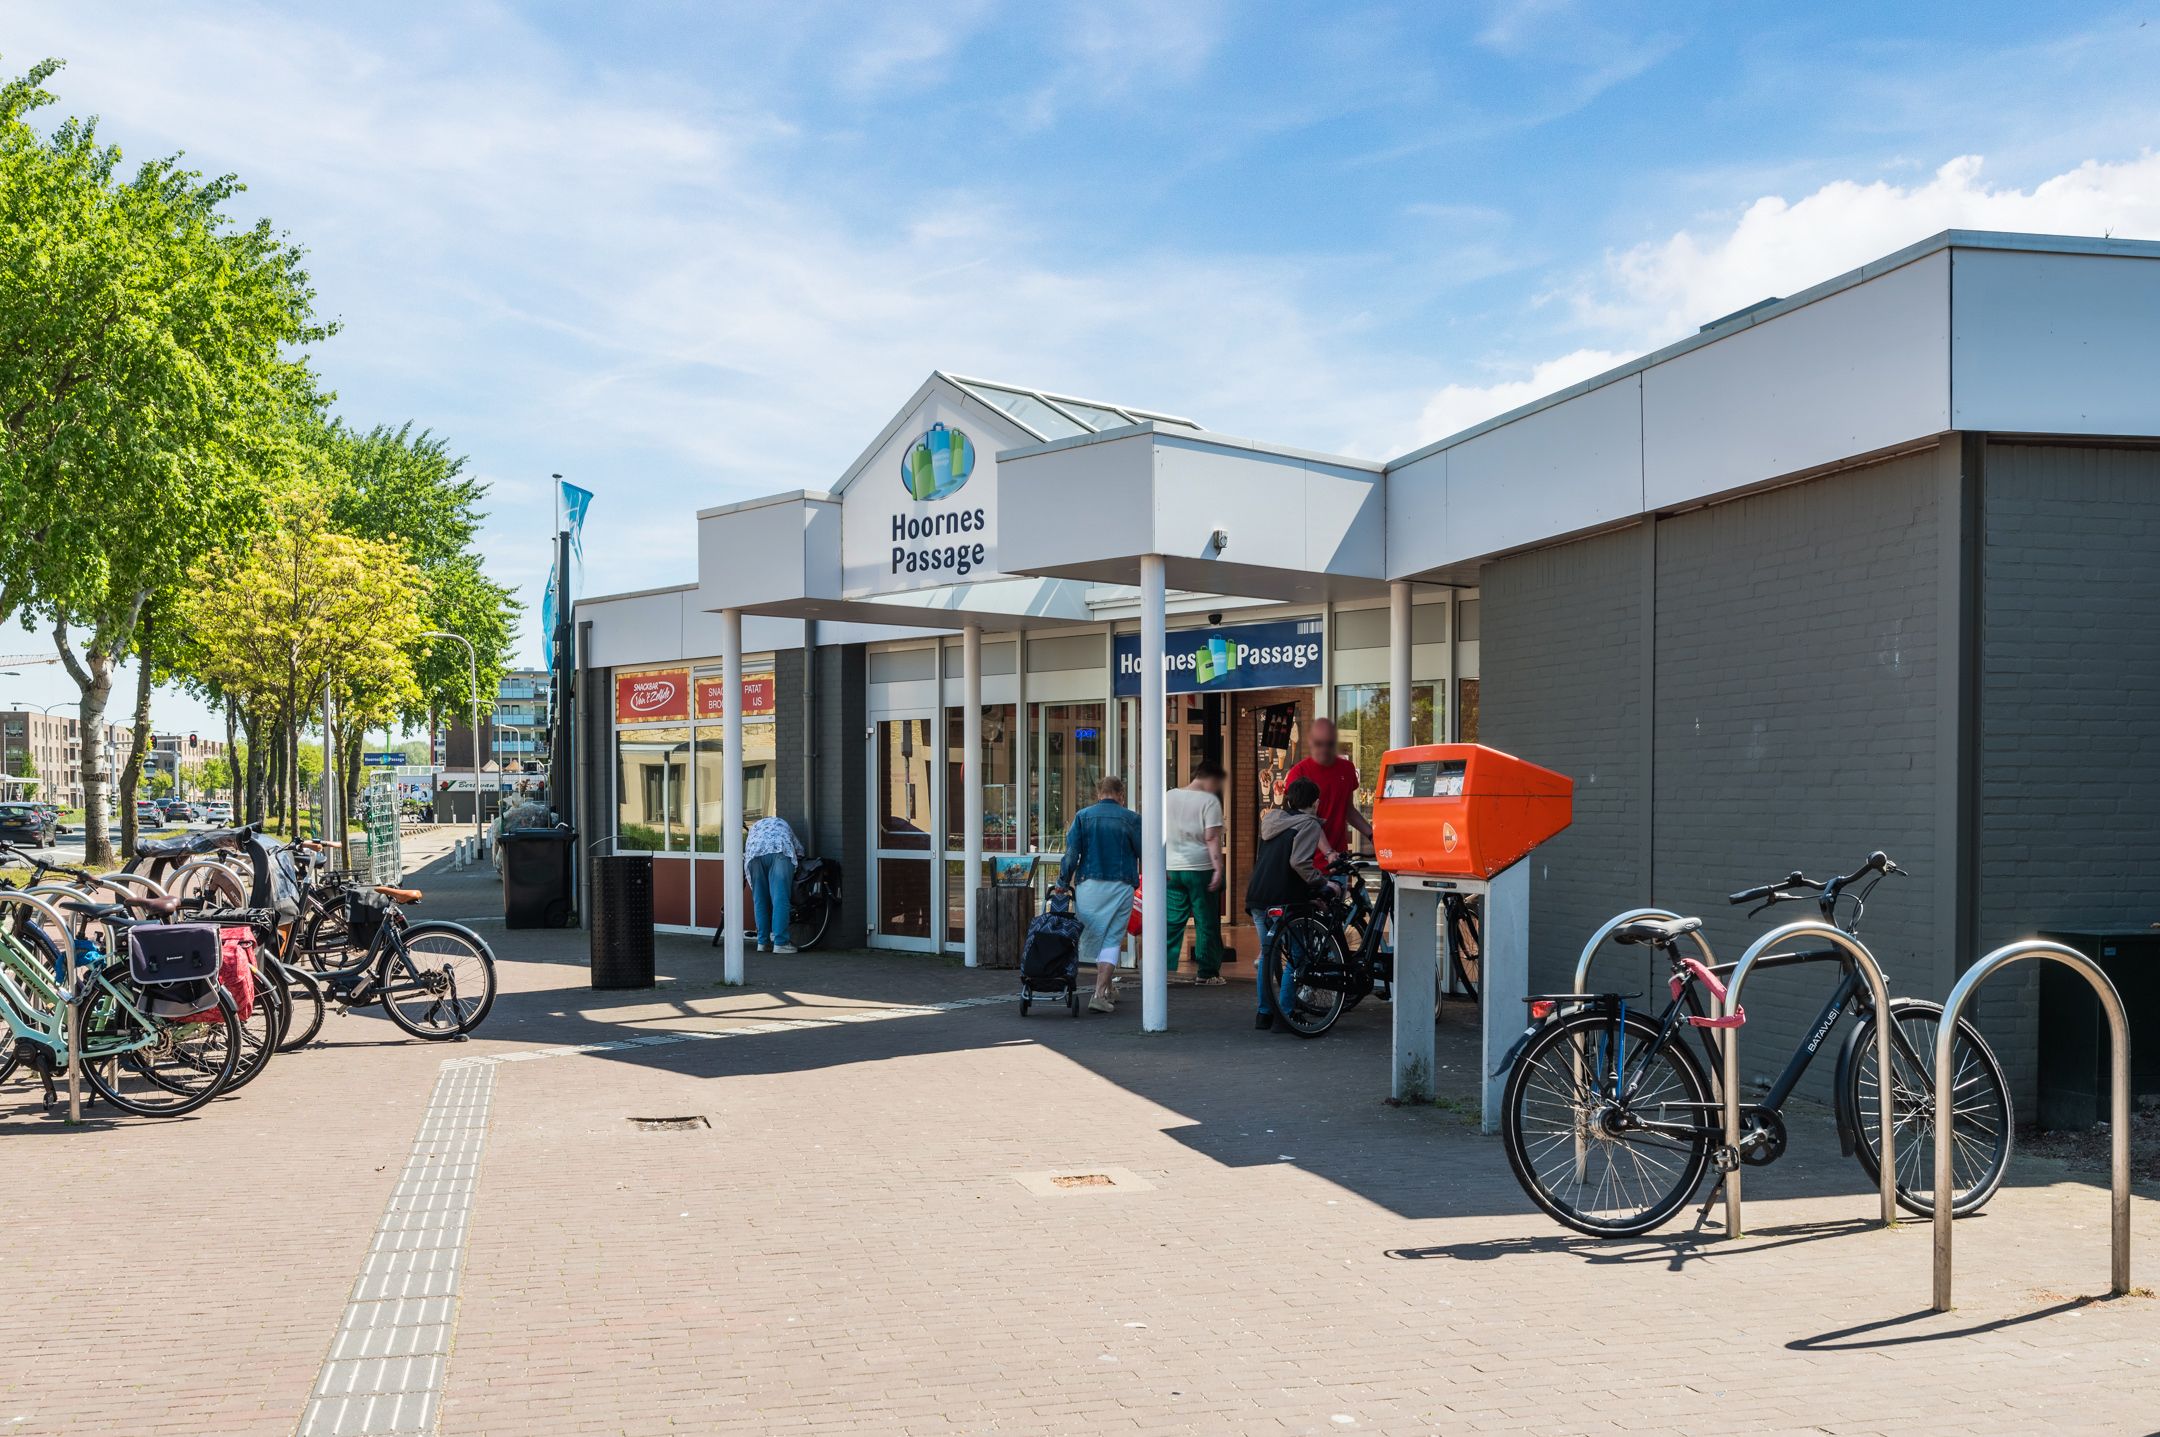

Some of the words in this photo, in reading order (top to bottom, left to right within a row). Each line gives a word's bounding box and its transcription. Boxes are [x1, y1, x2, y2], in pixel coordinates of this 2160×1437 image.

[892, 508, 985, 541] Hoornes
[892, 543, 985, 576] Passage
[1120, 653, 1196, 674] Hones
[1237, 643, 1319, 668] Passage
[633, 682, 659, 692] SNACKBAR
[744, 684, 762, 694] PATAT
[752, 696, 763, 706] IJS
[10, 962, 50, 1000] BATAVUS
[1807, 1010, 1838, 1052] BATAVUS
